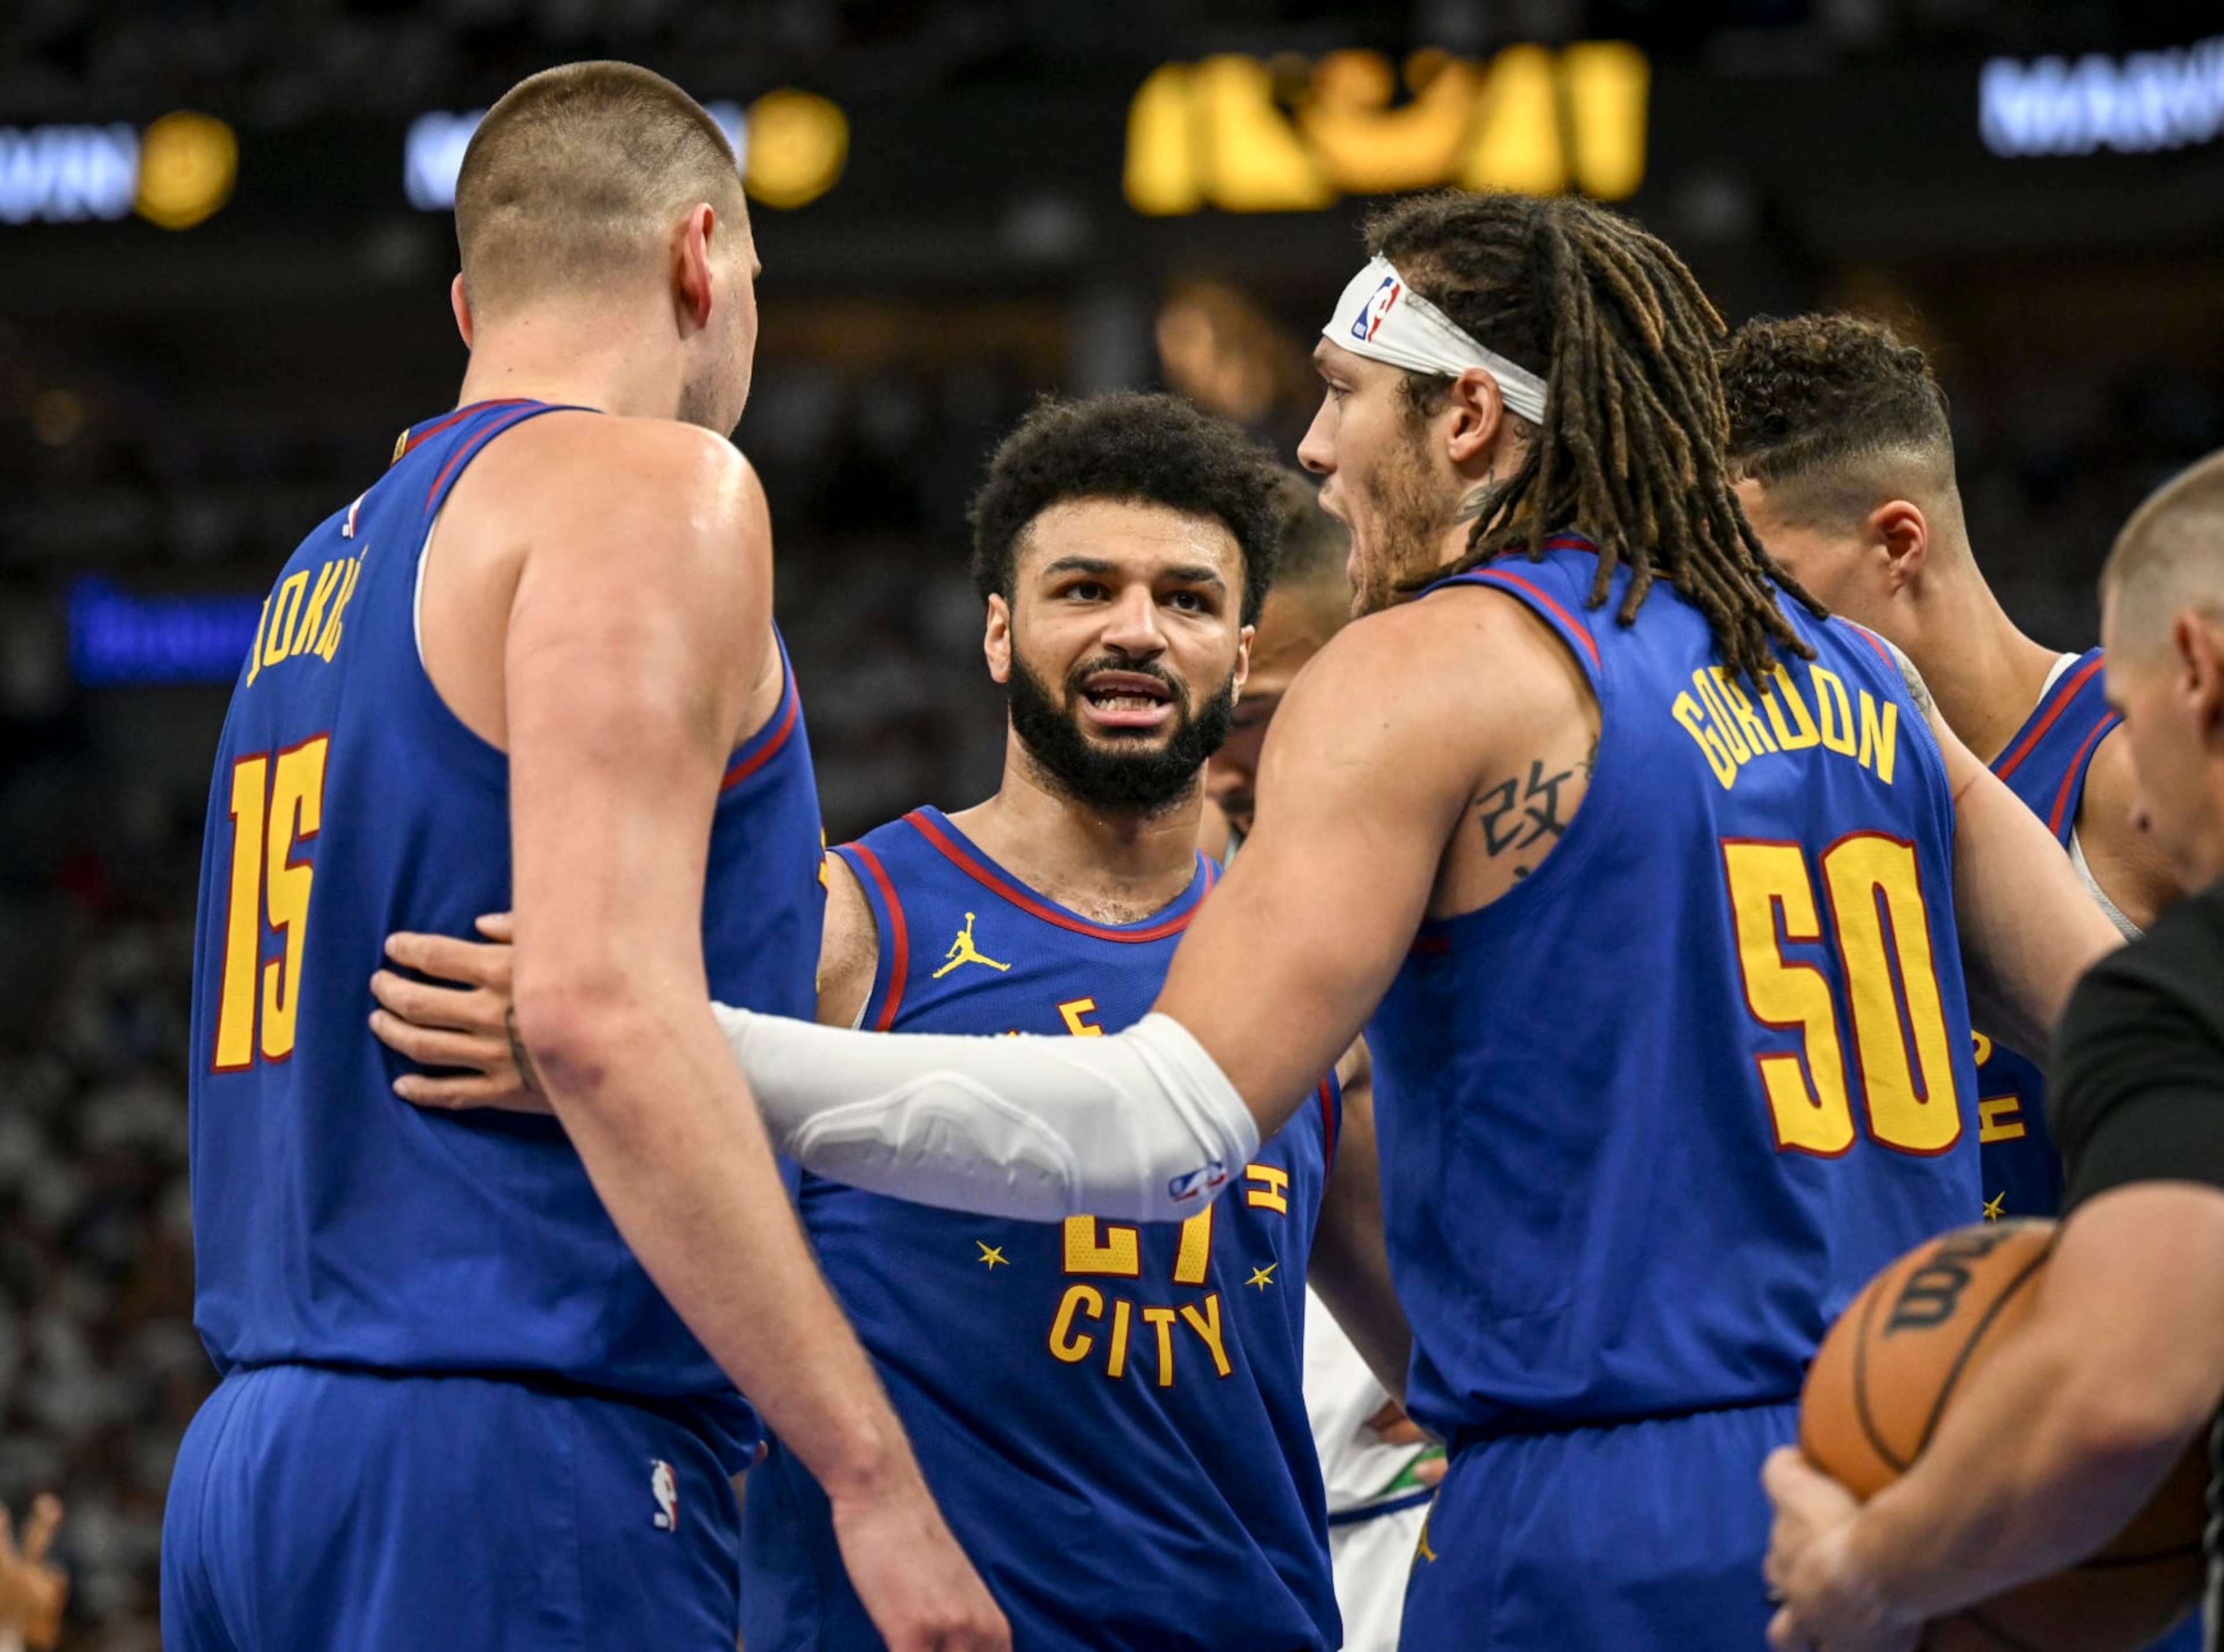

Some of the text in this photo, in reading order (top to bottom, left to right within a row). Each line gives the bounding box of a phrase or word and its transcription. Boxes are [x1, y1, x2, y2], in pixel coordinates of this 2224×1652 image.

[1671, 662, 1898, 791] GORDON
[211, 732, 331, 1073] 15
[1720, 830, 1962, 1159] 50
[1048, 1284, 1232, 1389] CITY
